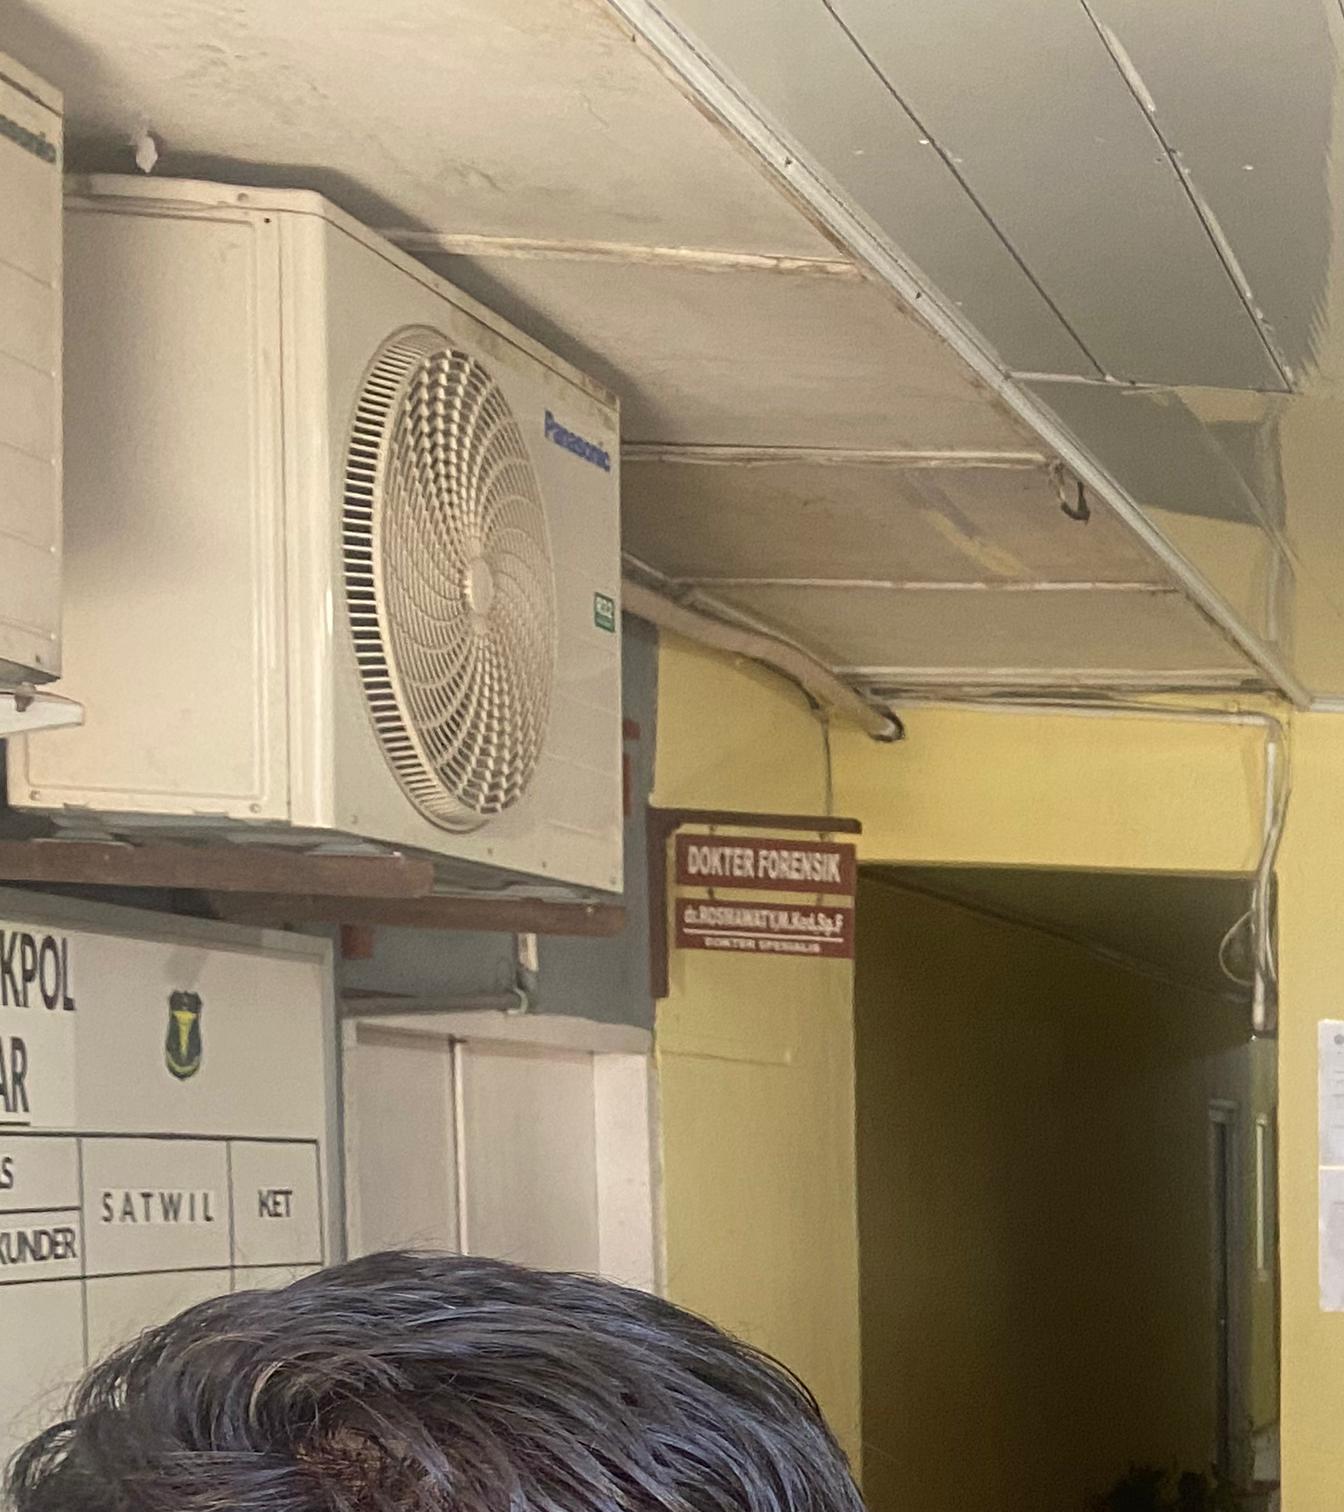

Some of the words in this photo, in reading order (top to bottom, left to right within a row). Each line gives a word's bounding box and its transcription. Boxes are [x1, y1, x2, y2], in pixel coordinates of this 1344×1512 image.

[545, 409, 611, 472] Panasonic
[687, 845, 755, 878] DOKTER
[758, 849, 841, 883] FORENSIK
[101, 1191, 215, 1223] SATWIL
[257, 1188, 294, 1219] KET
